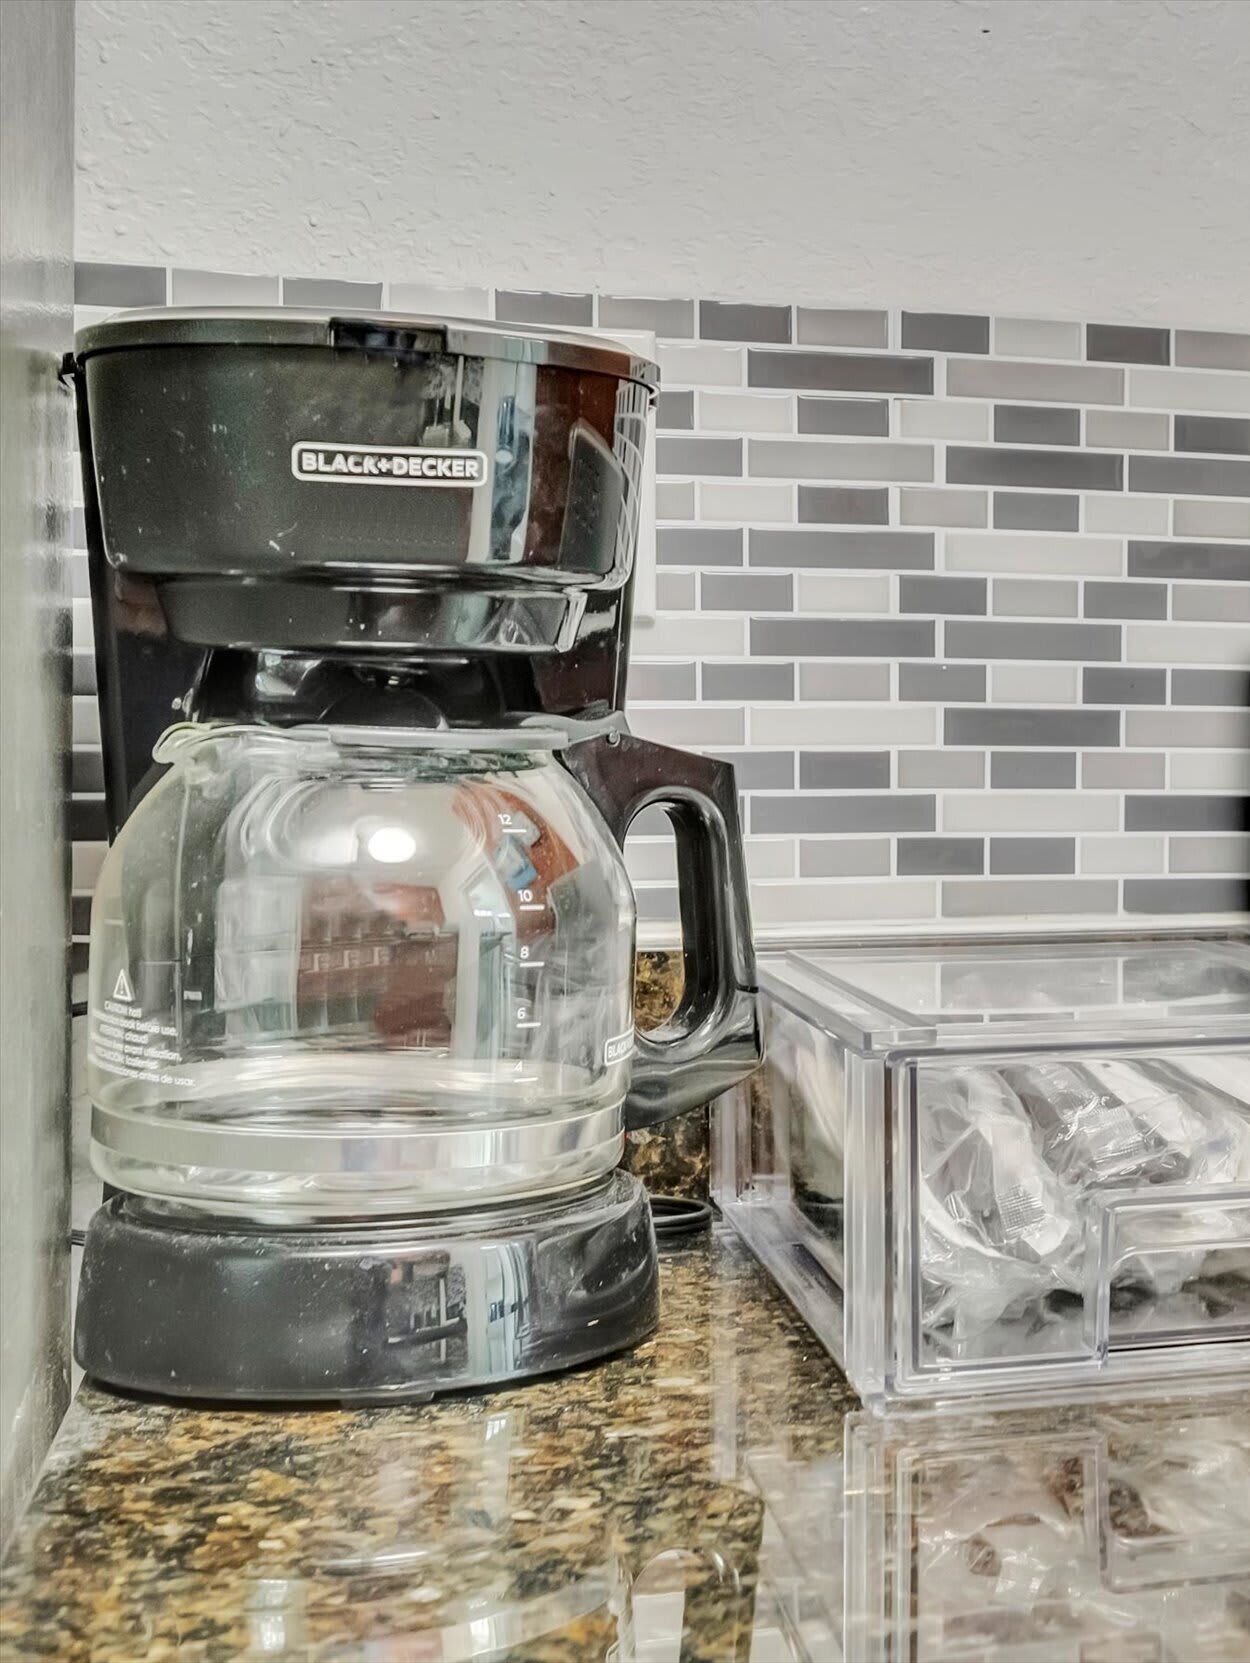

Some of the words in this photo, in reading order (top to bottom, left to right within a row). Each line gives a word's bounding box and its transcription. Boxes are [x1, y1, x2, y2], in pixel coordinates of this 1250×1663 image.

[301, 451, 479, 478] BLACK+DECKER
[498, 814, 512, 825] 12
[518, 890, 533, 902] 10
[520, 946, 530, 959] 8
[517, 1007, 526, 1019] 6
[513, 1060, 523, 1073] 4
